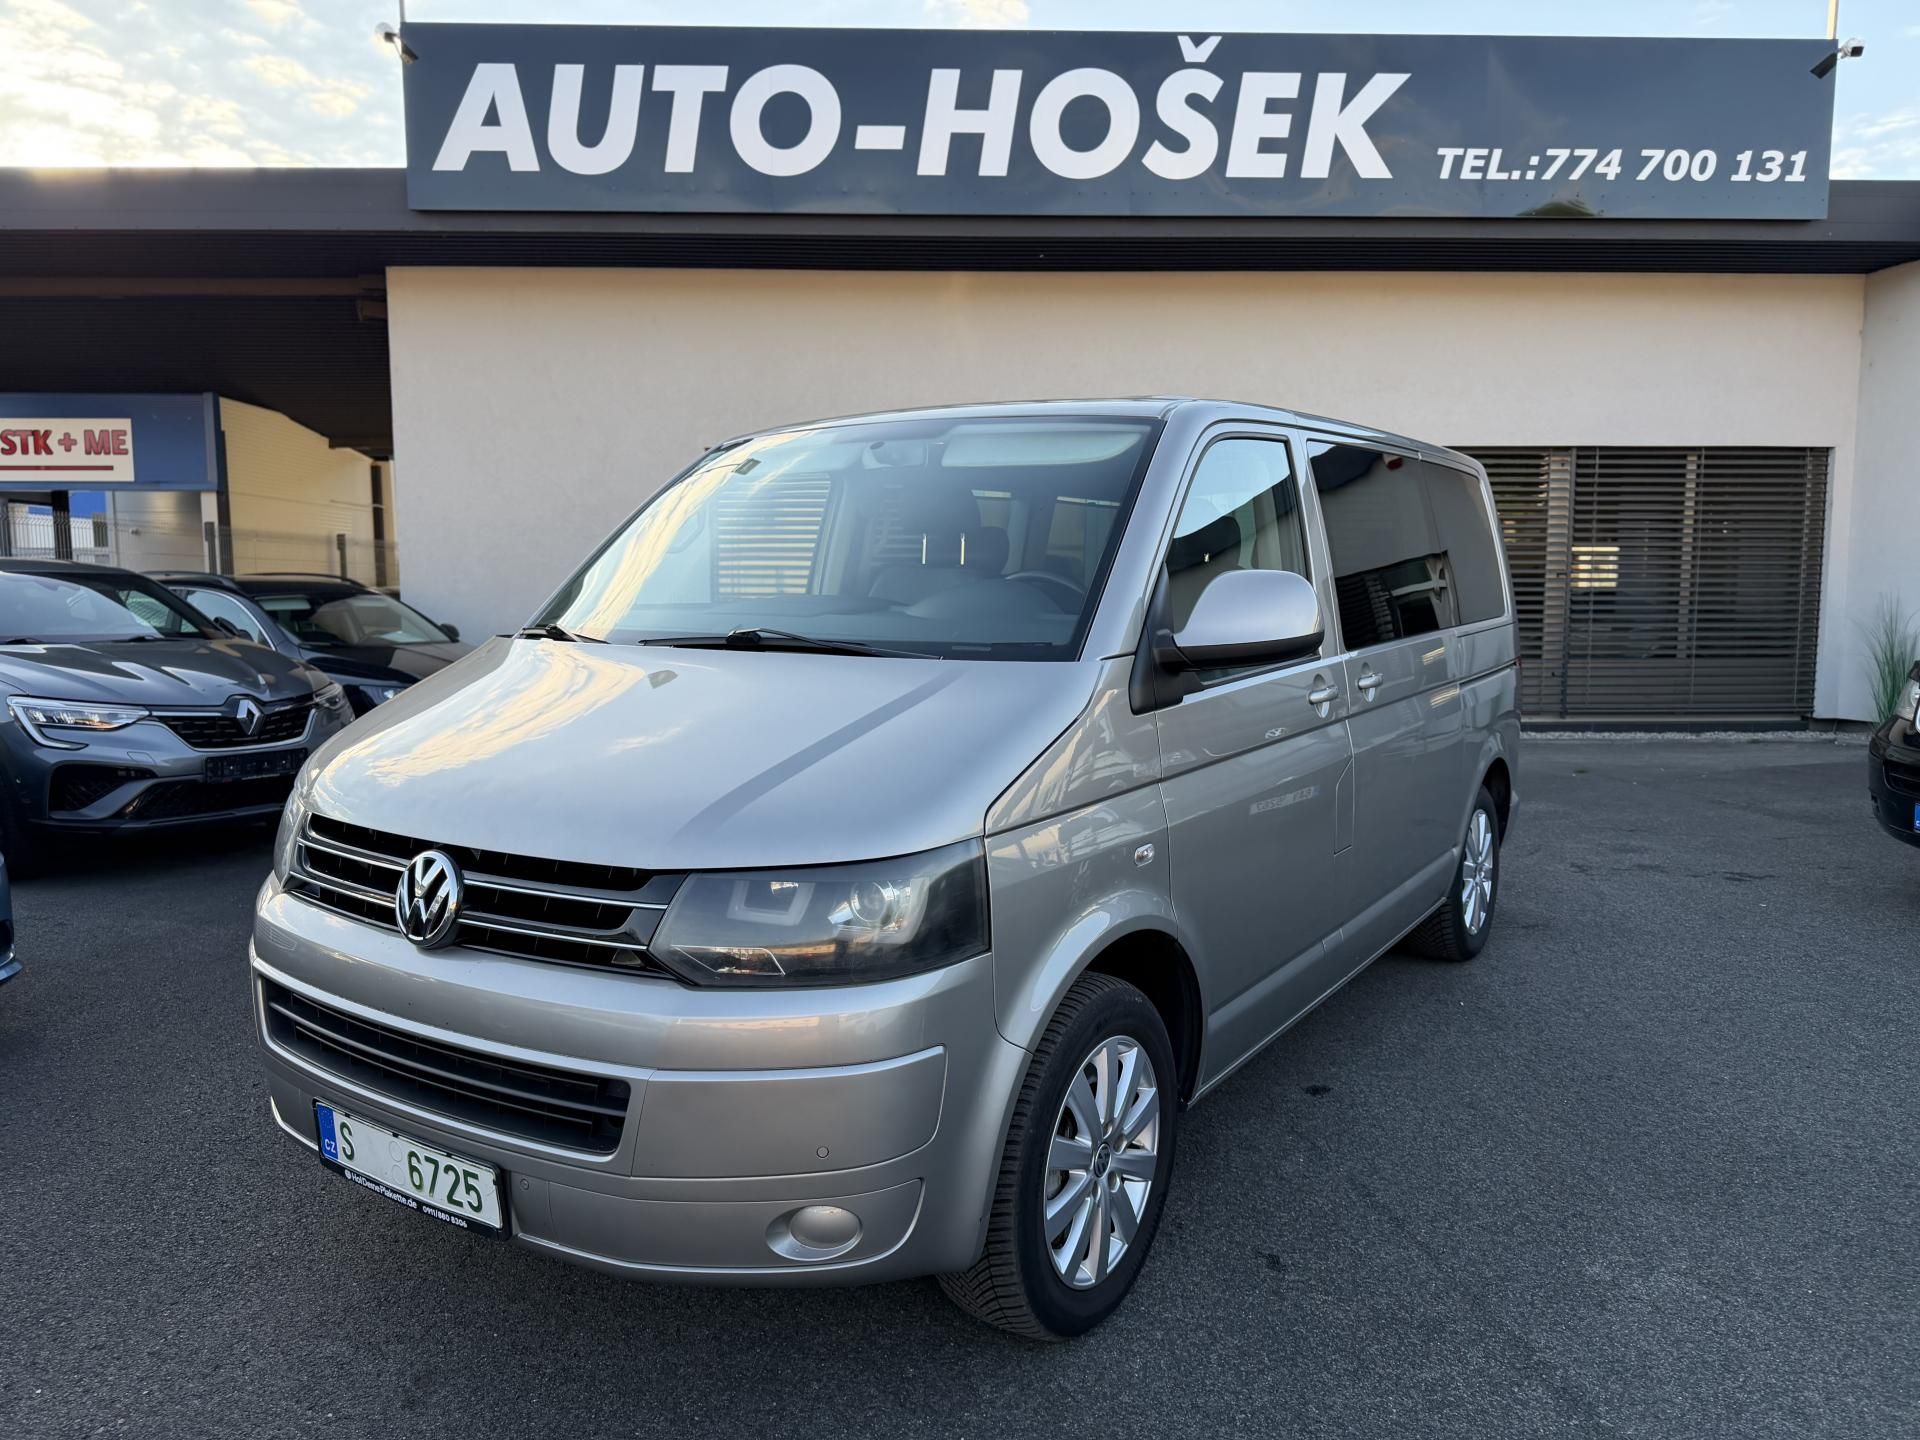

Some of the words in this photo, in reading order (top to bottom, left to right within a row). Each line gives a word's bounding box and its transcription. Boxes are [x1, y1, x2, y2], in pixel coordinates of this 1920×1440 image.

[432, 35, 1412, 180] AUTO-HOŠEK
[1437, 147, 1622, 180] TEL.:774
[1636, 149, 1717, 182] 700
[1730, 150, 1808, 183] 131
[0, 429, 54, 456] STK
[84, 429, 129, 456] ME
[324, 1138, 337, 1154] CZ
[339, 1121, 355, 1162] S
[407, 1150, 483, 1213] 6725
